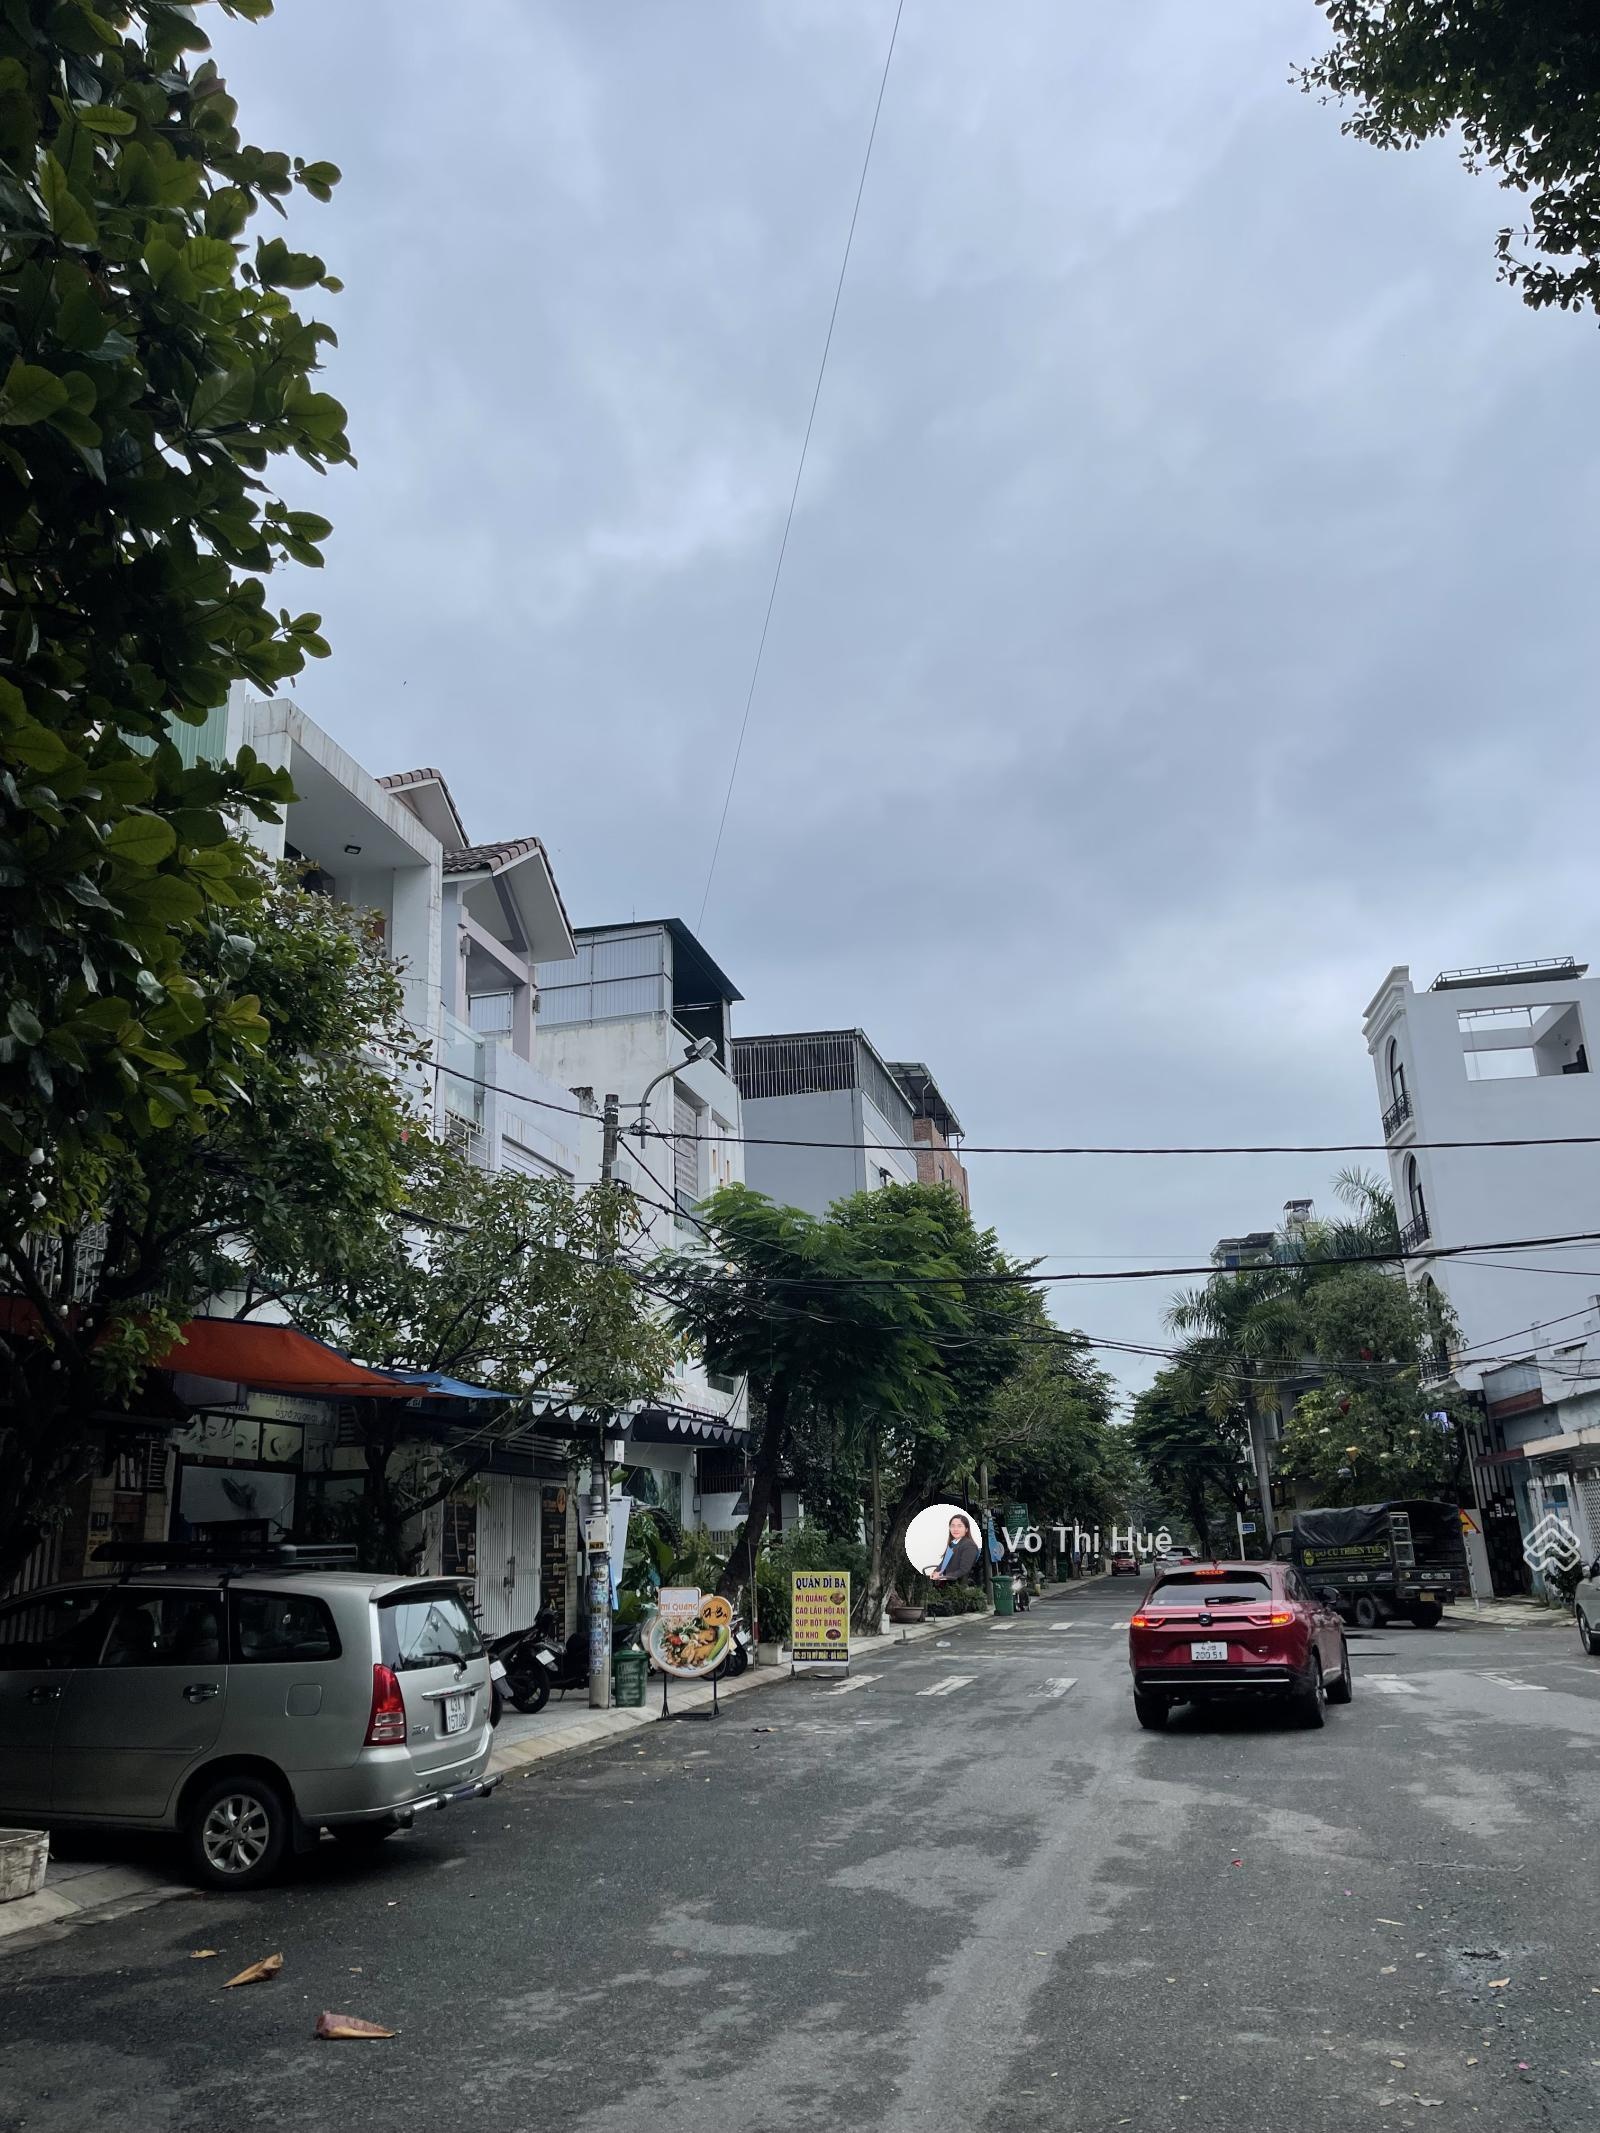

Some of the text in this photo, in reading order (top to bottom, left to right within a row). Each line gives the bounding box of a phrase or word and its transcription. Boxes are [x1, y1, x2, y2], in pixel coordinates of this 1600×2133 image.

[796, 1575, 820, 1590] QUÁN
[834, 1578, 846, 1588] BA
[795, 1607, 808, 1615] CAO
[805, 1631, 819, 1639] KHO
[450, 1696, 462, 1712] 43A
